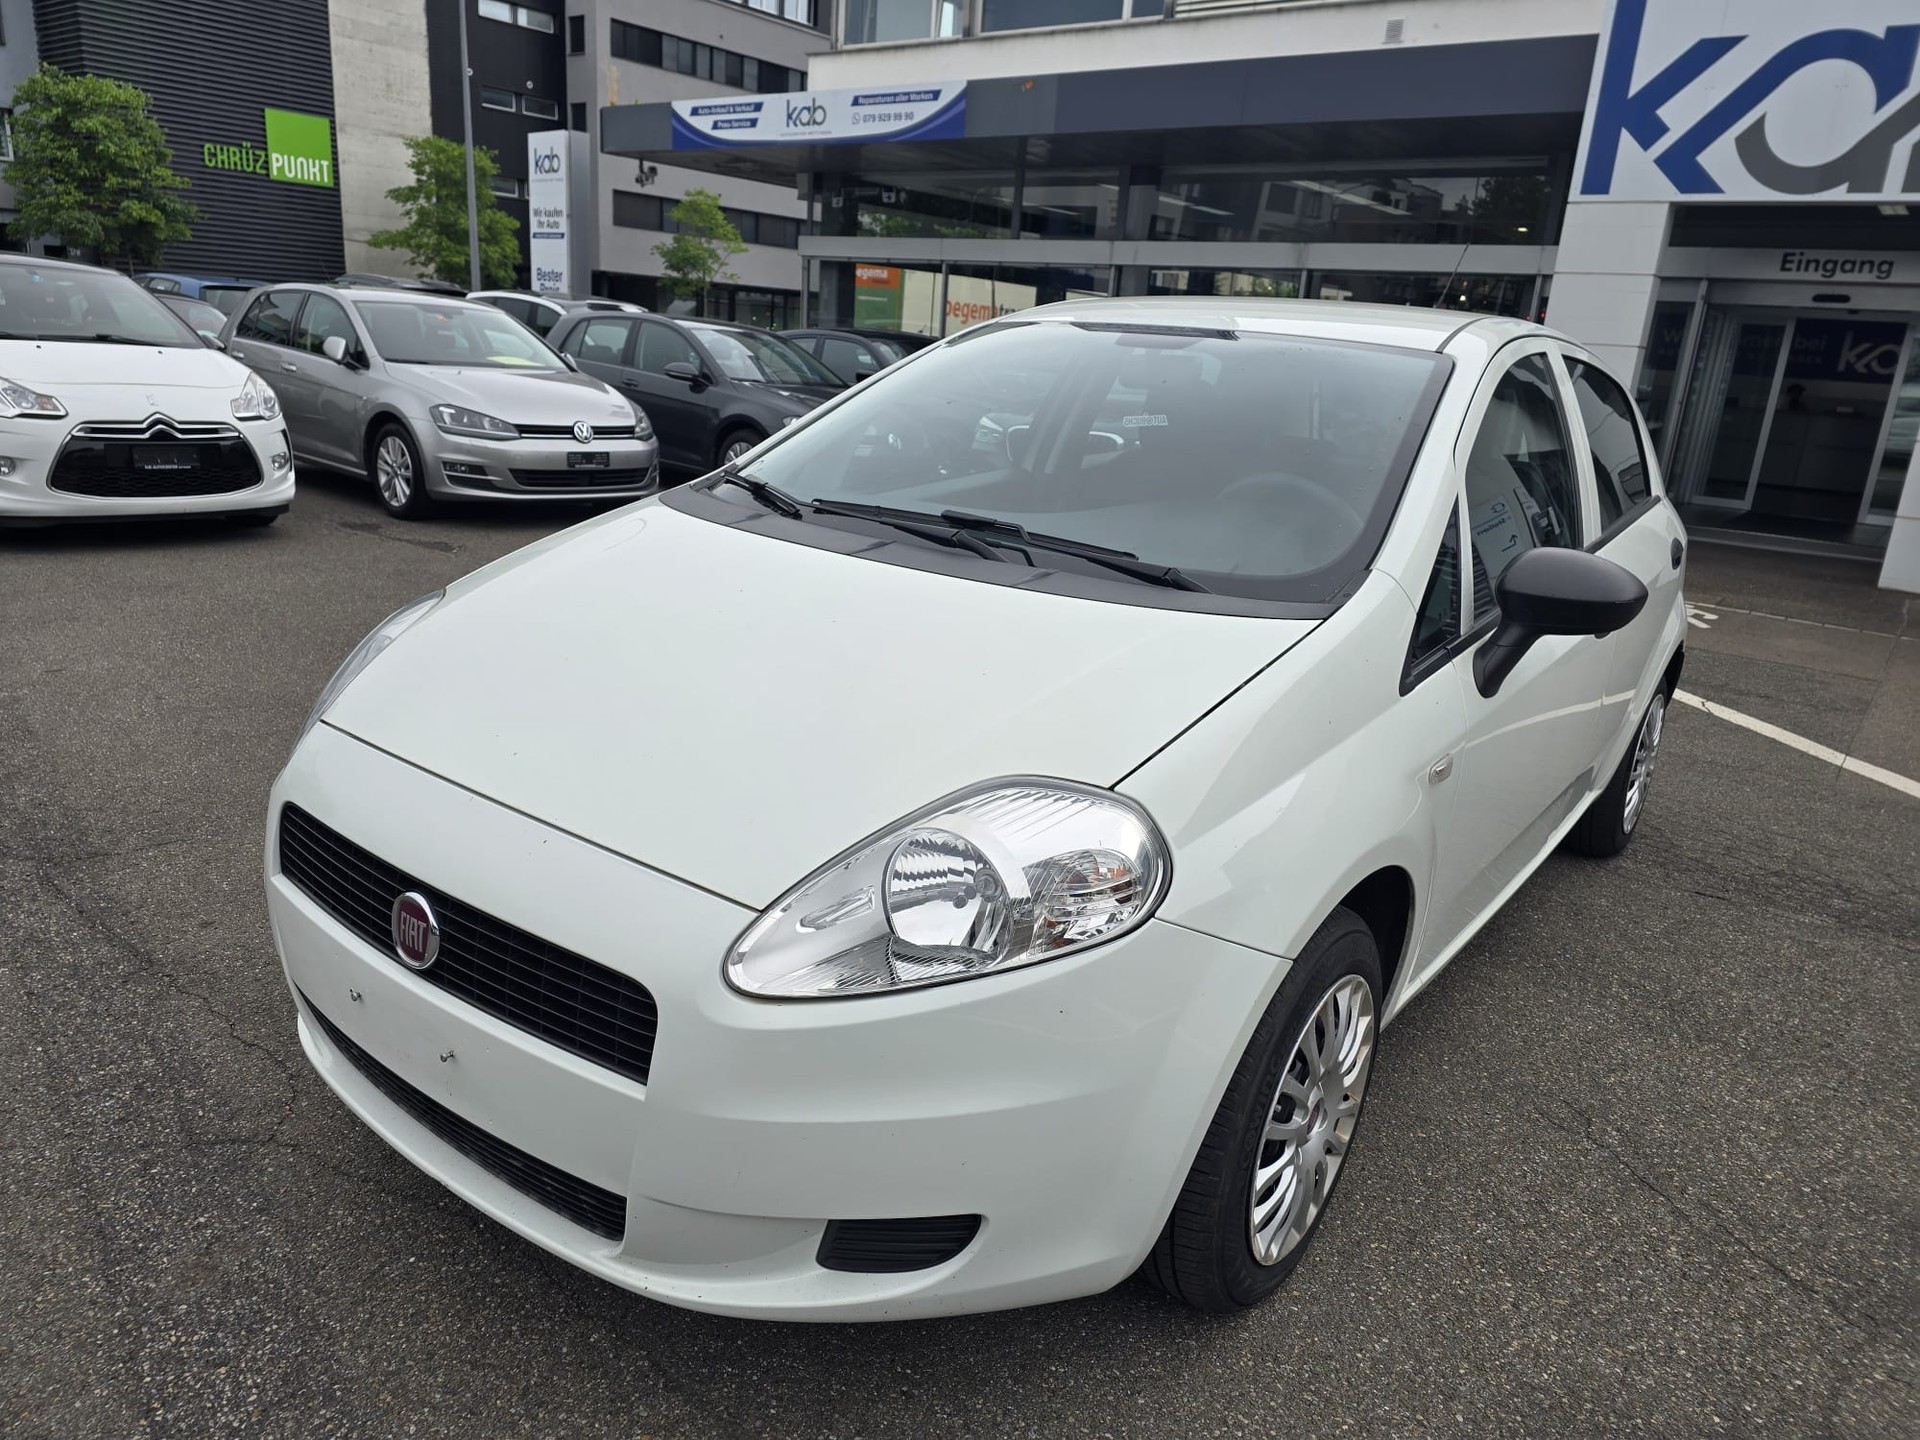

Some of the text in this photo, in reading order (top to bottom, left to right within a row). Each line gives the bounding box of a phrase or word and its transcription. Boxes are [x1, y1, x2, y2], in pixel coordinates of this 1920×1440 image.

[786, 97, 827, 128] kab
[1580, 0, 1920, 195] ka
[203, 141, 329, 183] CHRÜZ PUNKT
[533, 146, 561, 175] kab
[533, 206, 563, 218] Wir kaufen
[546, 219, 560, 229] Auto
[537, 267, 563, 283] Bester
[1780, 251, 1895, 280] Eingang
[1837, 330, 1903, 374] ka
[400, 909, 427, 953] FIAT
